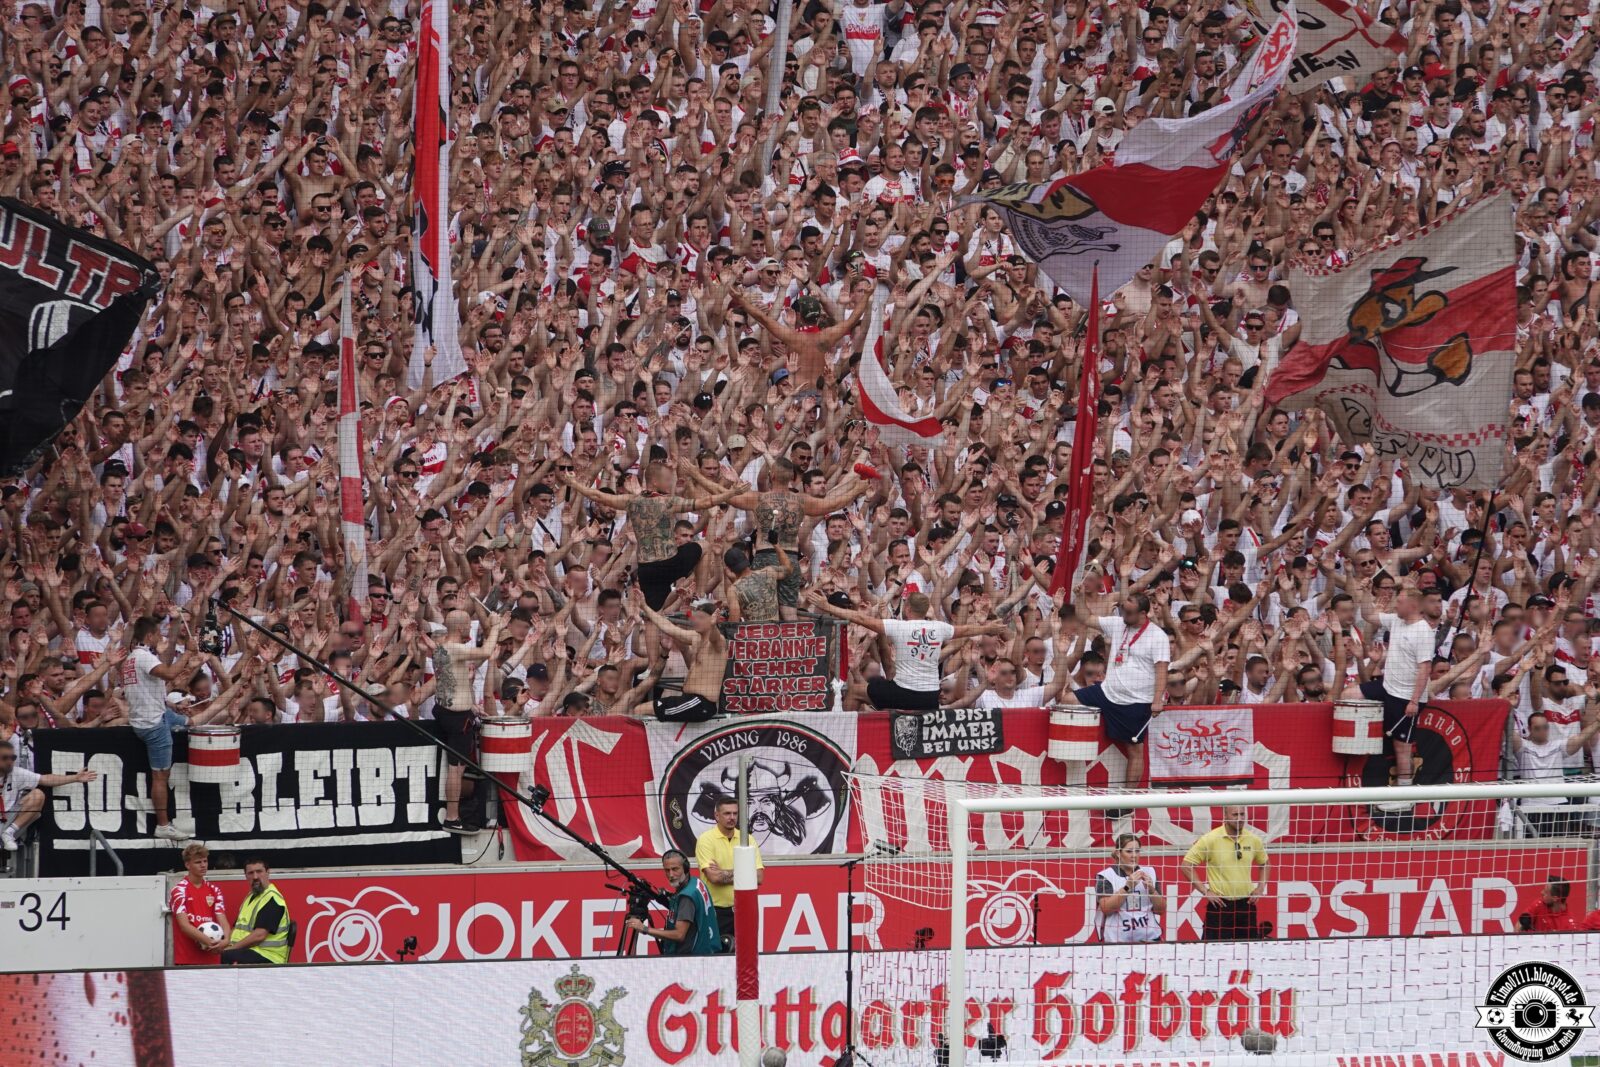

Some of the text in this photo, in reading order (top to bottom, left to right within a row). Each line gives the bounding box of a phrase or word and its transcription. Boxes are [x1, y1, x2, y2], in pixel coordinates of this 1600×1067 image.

[0, 204, 152, 311] ULTR
[734, 622, 816, 640] JEDER
[733, 658, 819, 677] KEHRT
[922, 708, 994, 725] DU BIST
[922, 721, 997, 741] IMMER
[700, 729, 808, 762] VIKING 1986
[922, 736, 998, 754] BEI UNS!
[19, 892, 71, 932] 34
[419, 892, 885, 961] JOKETAR
[1064, 877, 1519, 944] JKRSTAR
[1032, 969, 1298, 1060] Hofbräu
